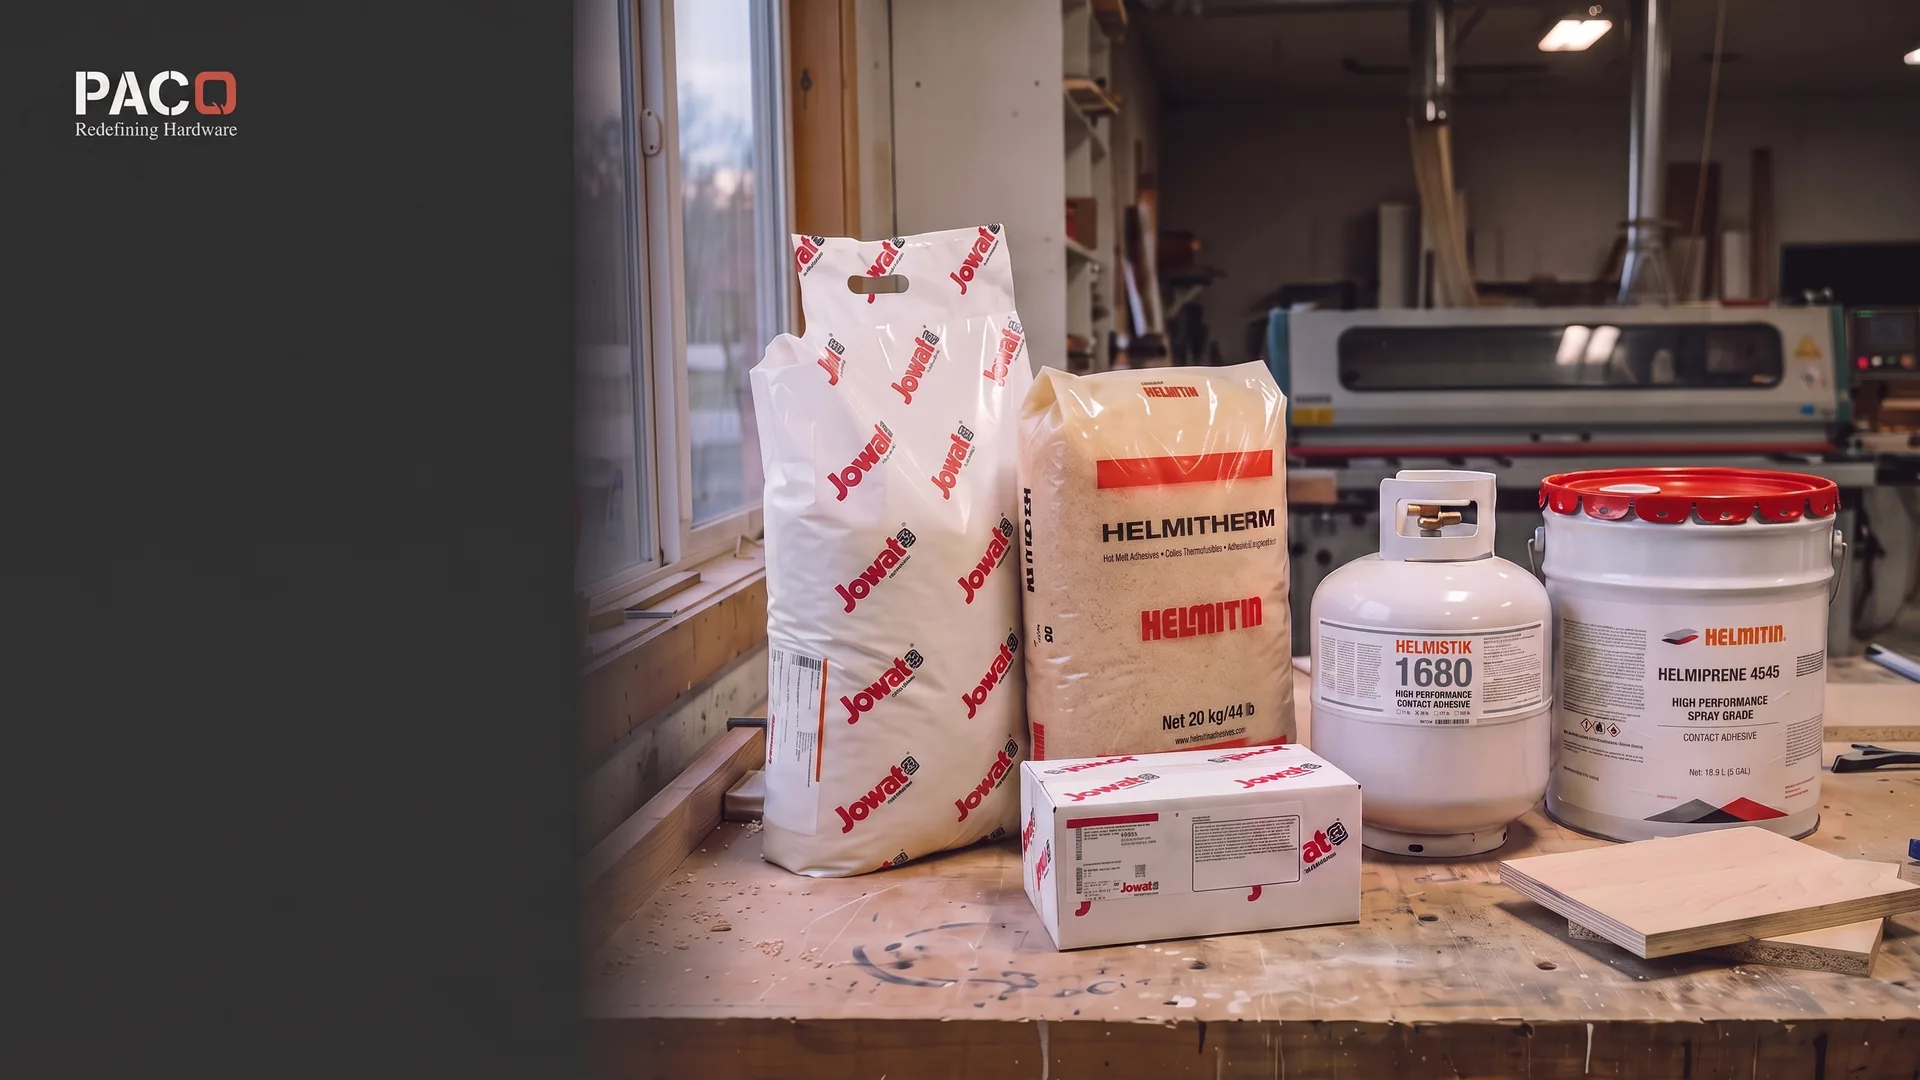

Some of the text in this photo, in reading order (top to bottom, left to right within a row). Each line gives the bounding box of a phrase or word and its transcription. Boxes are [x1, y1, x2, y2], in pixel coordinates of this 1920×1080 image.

[892, 336, 935, 406] Jowat
[931, 433, 971, 501] Jowat
[1102, 508, 1275, 542] HELMITHERM
[957, 526, 1009, 606] Jowat
[1103, 554, 1115, 563] Hot
[1115, 552, 1129, 562] Melt
[1130, 550, 1160, 561] Adhesives
[1165, 548, 1183, 558] Colles
[1183, 544, 1223, 556] Thermofusibles
[834, 536, 904, 614] Jowat
[1141, 596, 1263, 642] HELMITIN
[1395, 639, 1473, 655] HELMISTIK
[961, 642, 1014, 720] Jowat
[1395, 657, 1473, 688] 1680
[1658, 665, 1780, 682] HELMIPRENE 4545
[839, 657, 913, 726] Jowat
[1395, 689, 1472, 699] HIGH PERFORMANCE
[1397, 699, 1471, 709] CONTACT ADHESIVE
[1672, 695, 1768, 708] HIGH PERFORMANCE
[1162, 713, 1186, 731] Net
[1188, 710, 1204, 727] 20
[1208, 703, 1243, 726] kg/44
[1687, 710, 1754, 721] SPRAY GRADE
[1683, 731, 1757, 742] CONTACT ADHESIVE
[954, 750, 1012, 823] Jowat
[1689, 767, 1751, 778] Net: 18.9 L (5 GAL)
[834, 765, 910, 835] Jowat
[1120, 881, 1153, 894] Jowat
